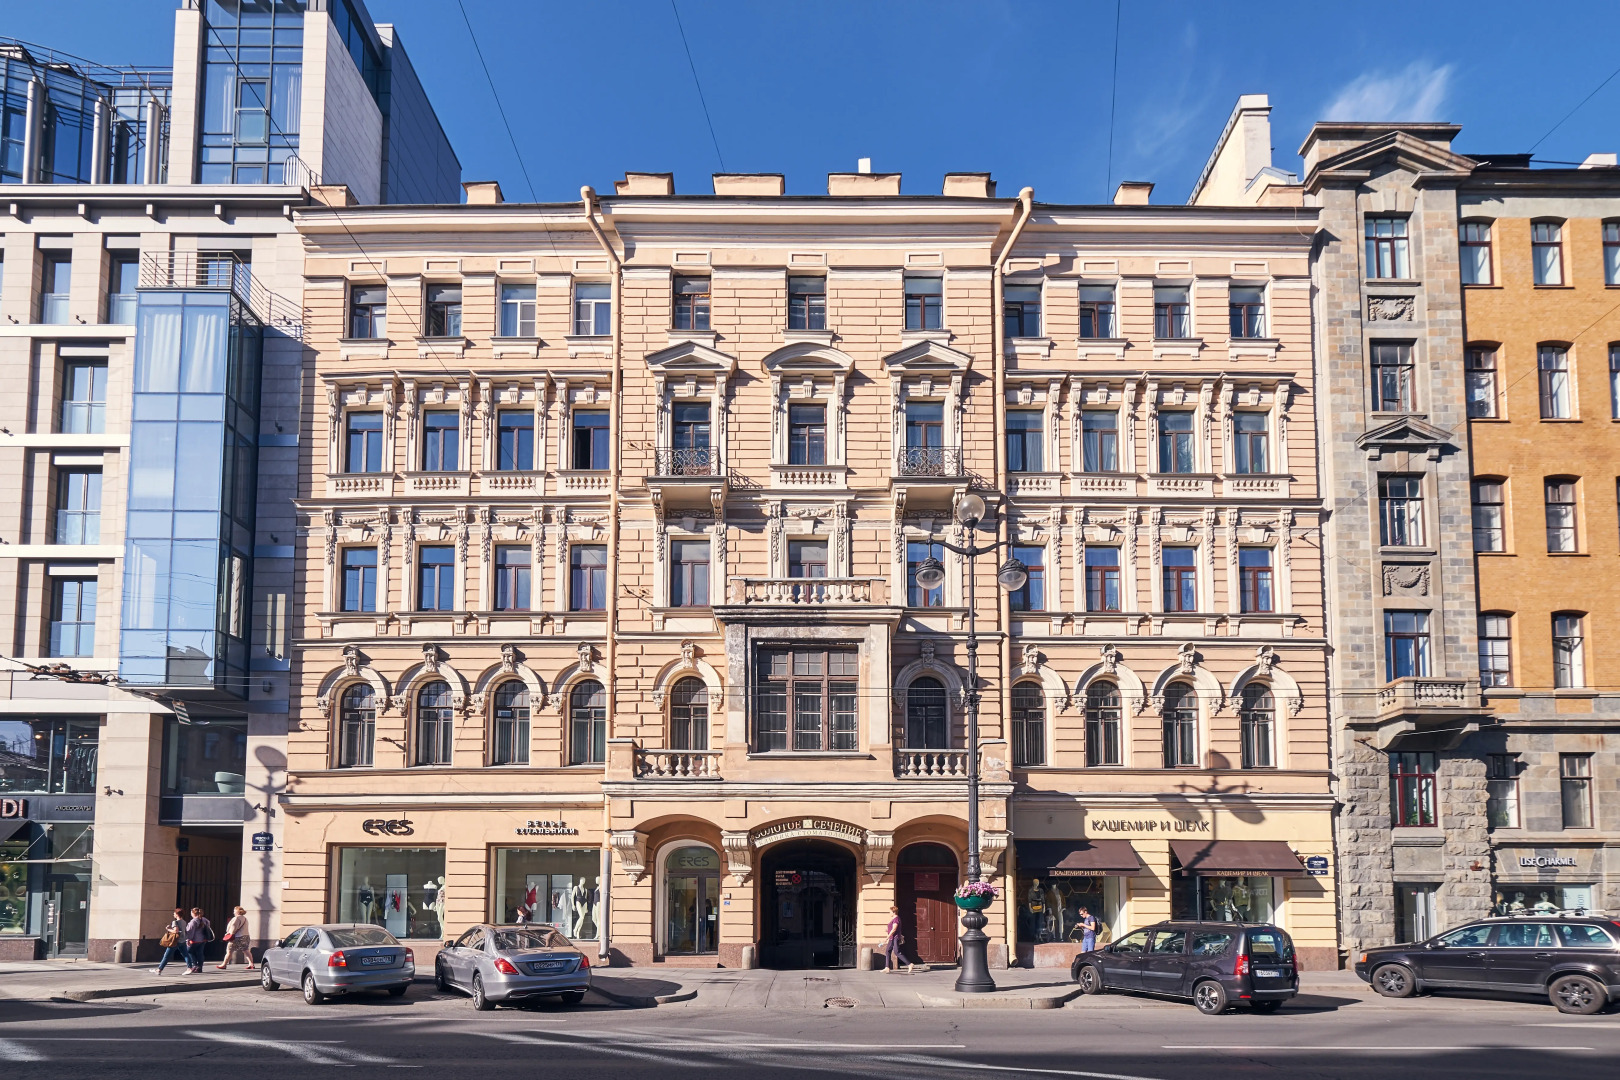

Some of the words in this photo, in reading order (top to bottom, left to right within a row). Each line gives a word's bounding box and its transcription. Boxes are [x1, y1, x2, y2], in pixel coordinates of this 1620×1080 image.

[362, 819, 412, 834] ERES
[814, 820, 863, 837] СЕЧЕНИЕ
[1092, 820, 1157, 832] КАШЕМИР
[1160, 820, 1171, 831] И
[1174, 820, 1210, 832] ШЕЛК
[679, 857, 709, 866] ERES
